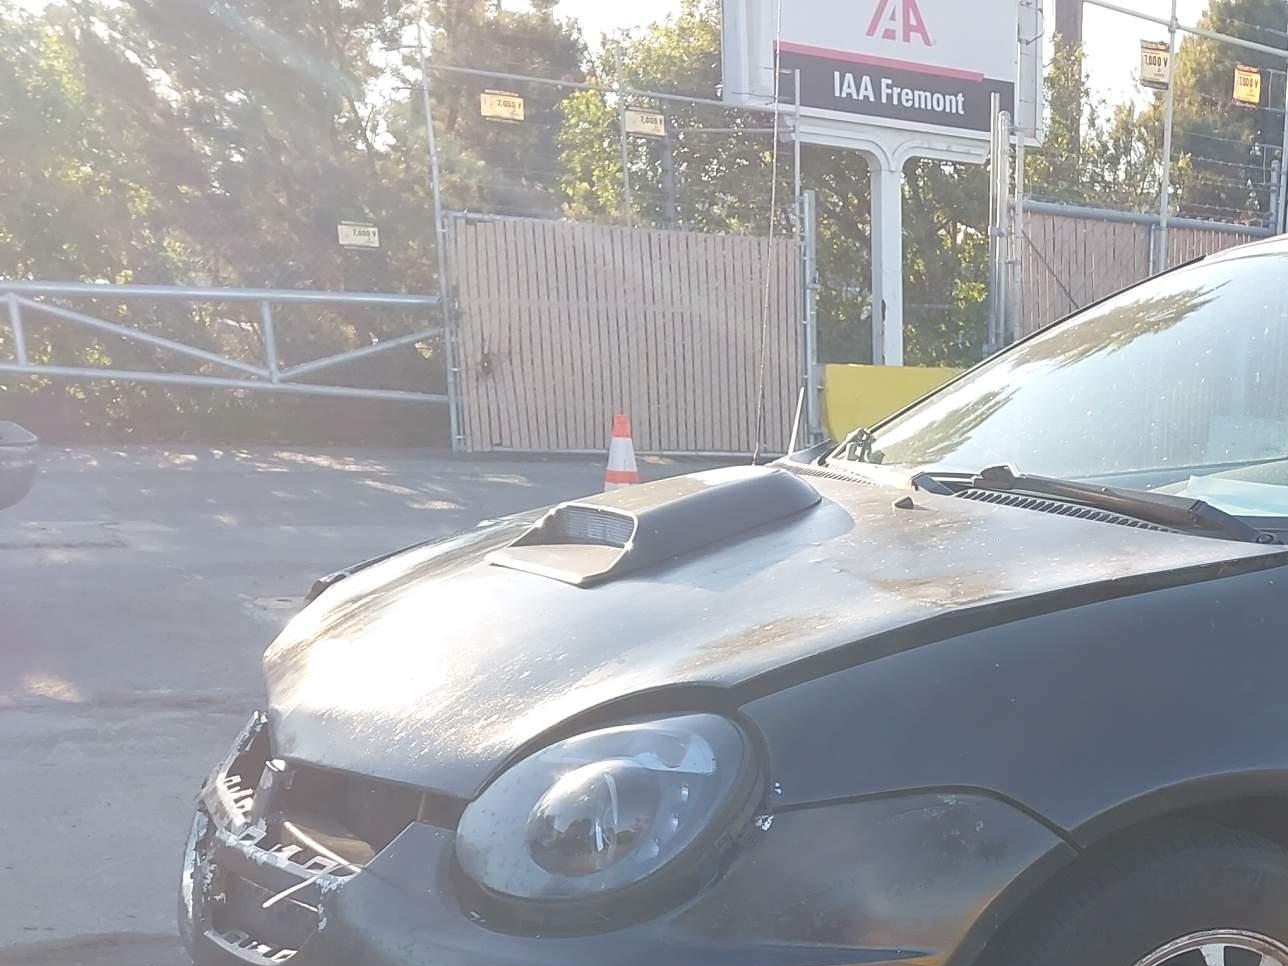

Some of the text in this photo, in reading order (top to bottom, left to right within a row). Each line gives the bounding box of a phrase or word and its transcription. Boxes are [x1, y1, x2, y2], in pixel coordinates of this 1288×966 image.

[1163, 56, 1169, 67] V
[833, 71, 965, 114] IAA Fremont
